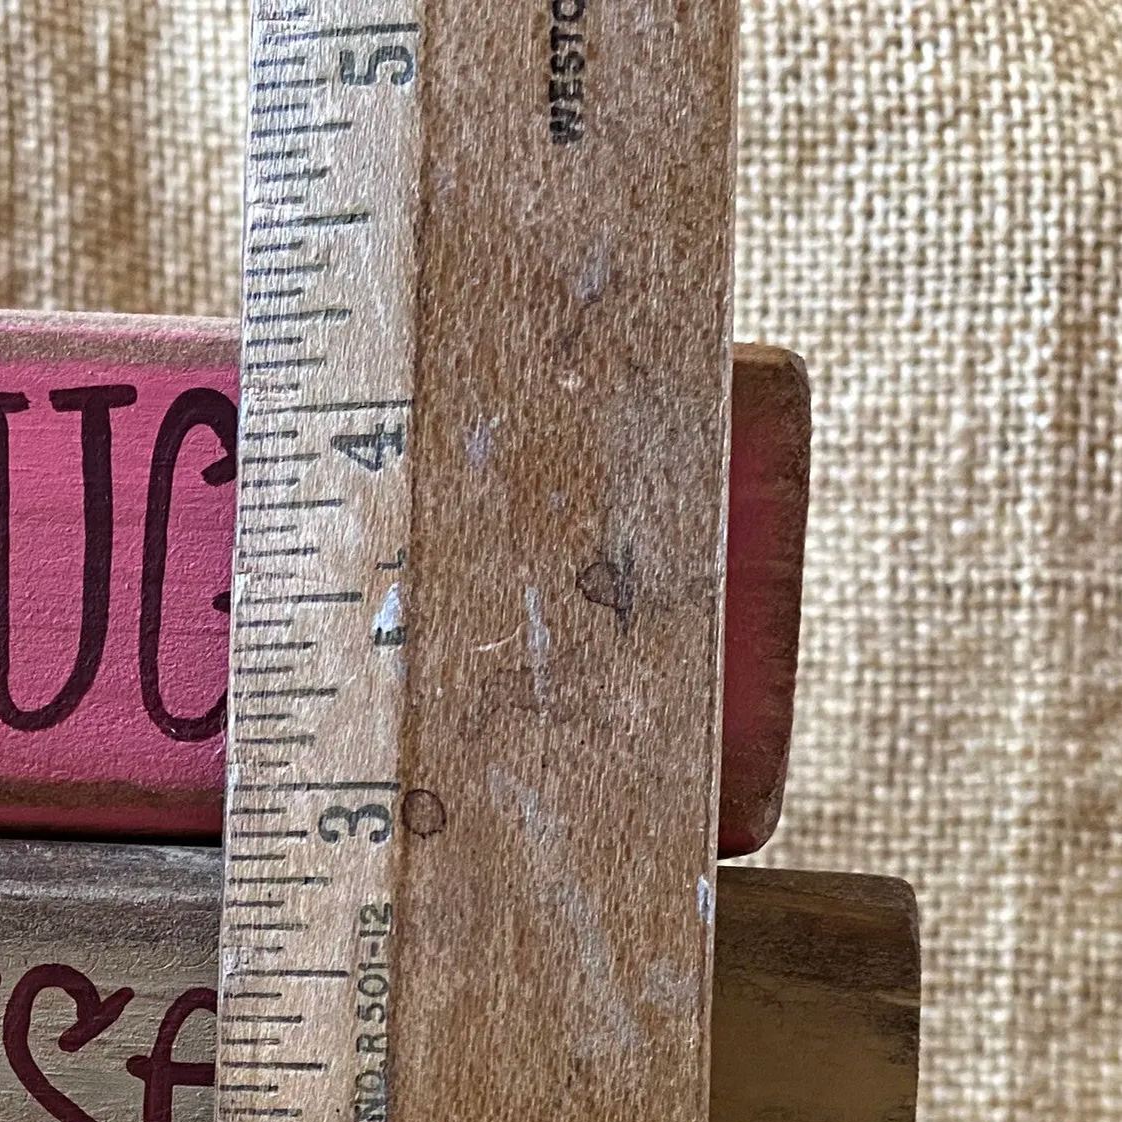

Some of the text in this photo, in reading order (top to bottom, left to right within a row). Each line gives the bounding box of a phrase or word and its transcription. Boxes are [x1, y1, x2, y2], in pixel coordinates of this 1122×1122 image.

[338, 45, 414, 87] 5
[330, 422, 406, 473] 4
[317, 803, 393, 845] 3
